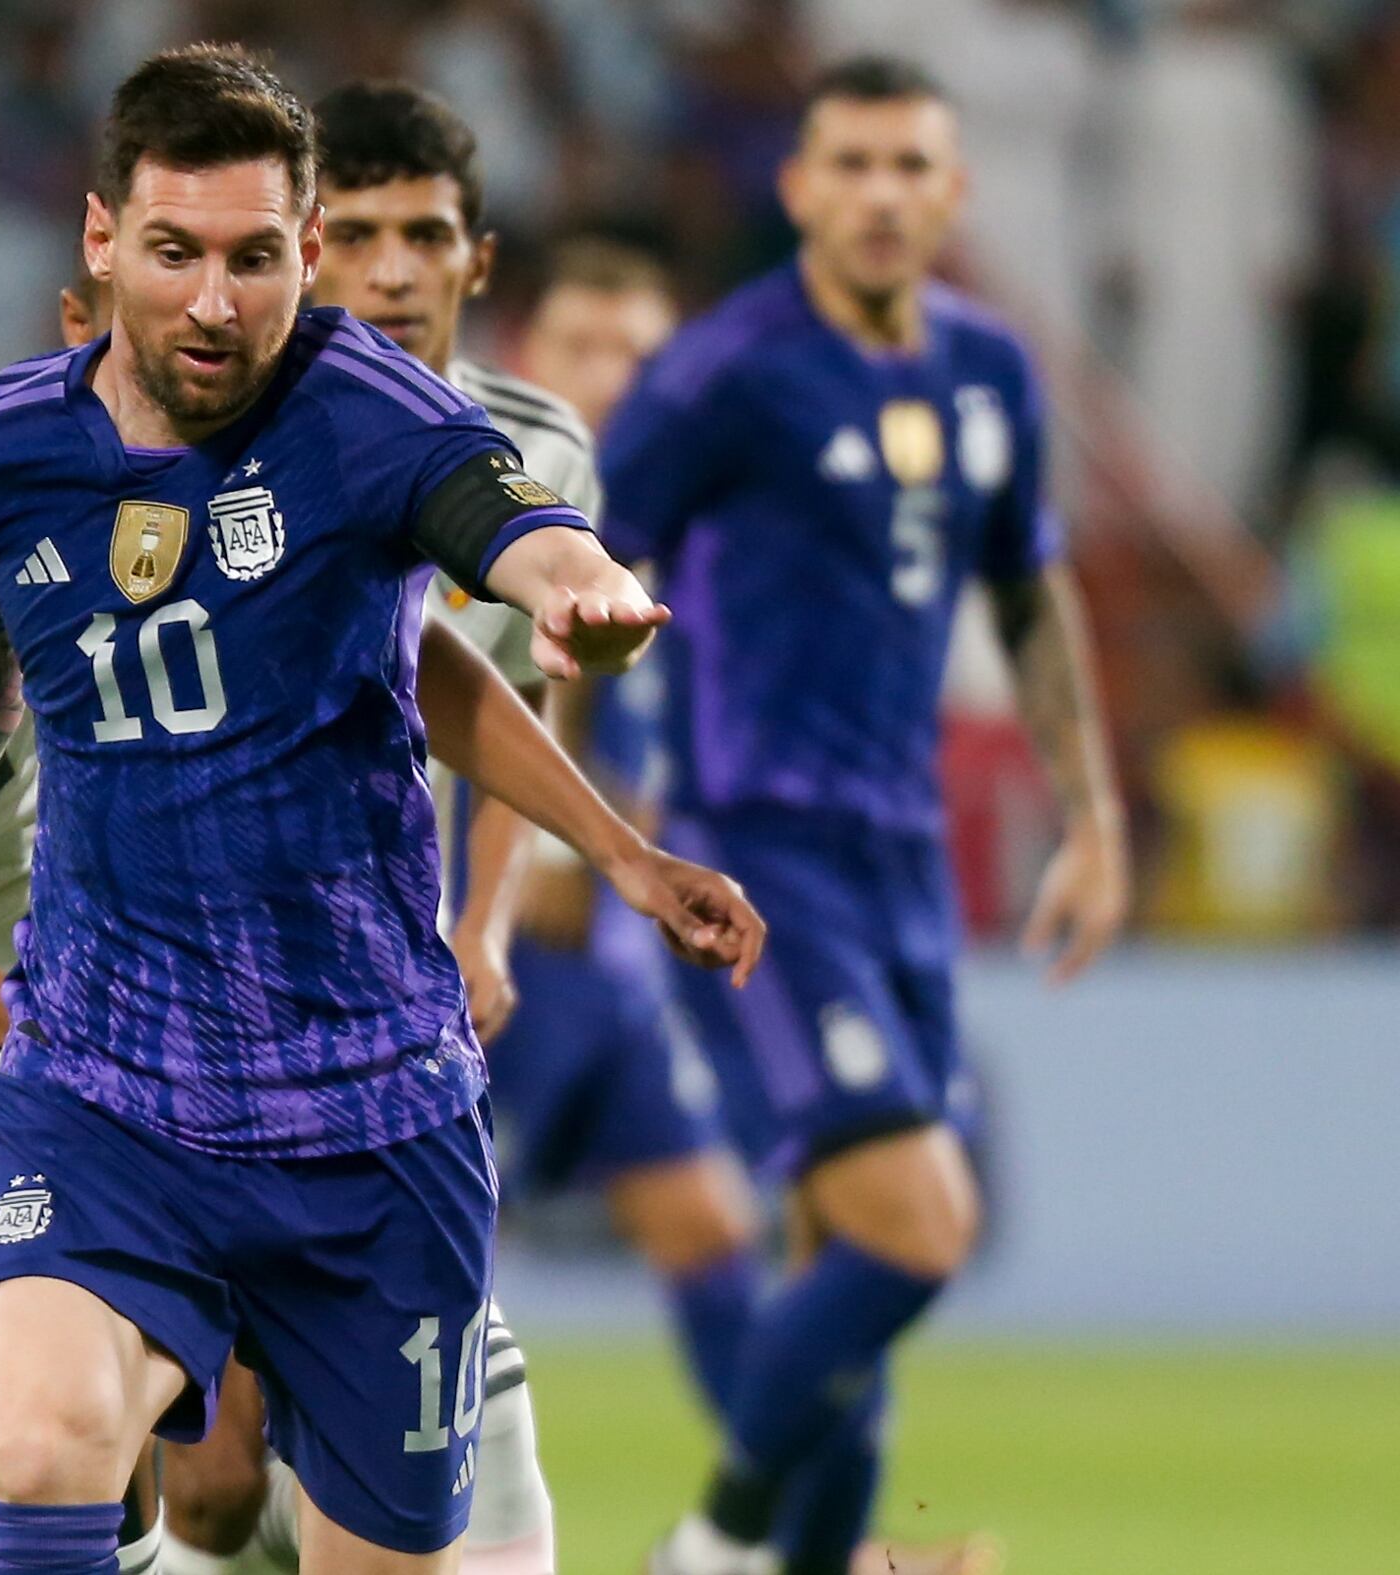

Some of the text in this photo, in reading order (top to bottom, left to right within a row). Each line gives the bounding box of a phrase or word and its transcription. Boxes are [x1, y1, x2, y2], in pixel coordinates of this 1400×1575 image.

[229, 514, 268, 554] AFA
[891, 487, 946, 605] 5
[76, 598, 227, 742] 10
[399, 1298, 488, 1452] 10
